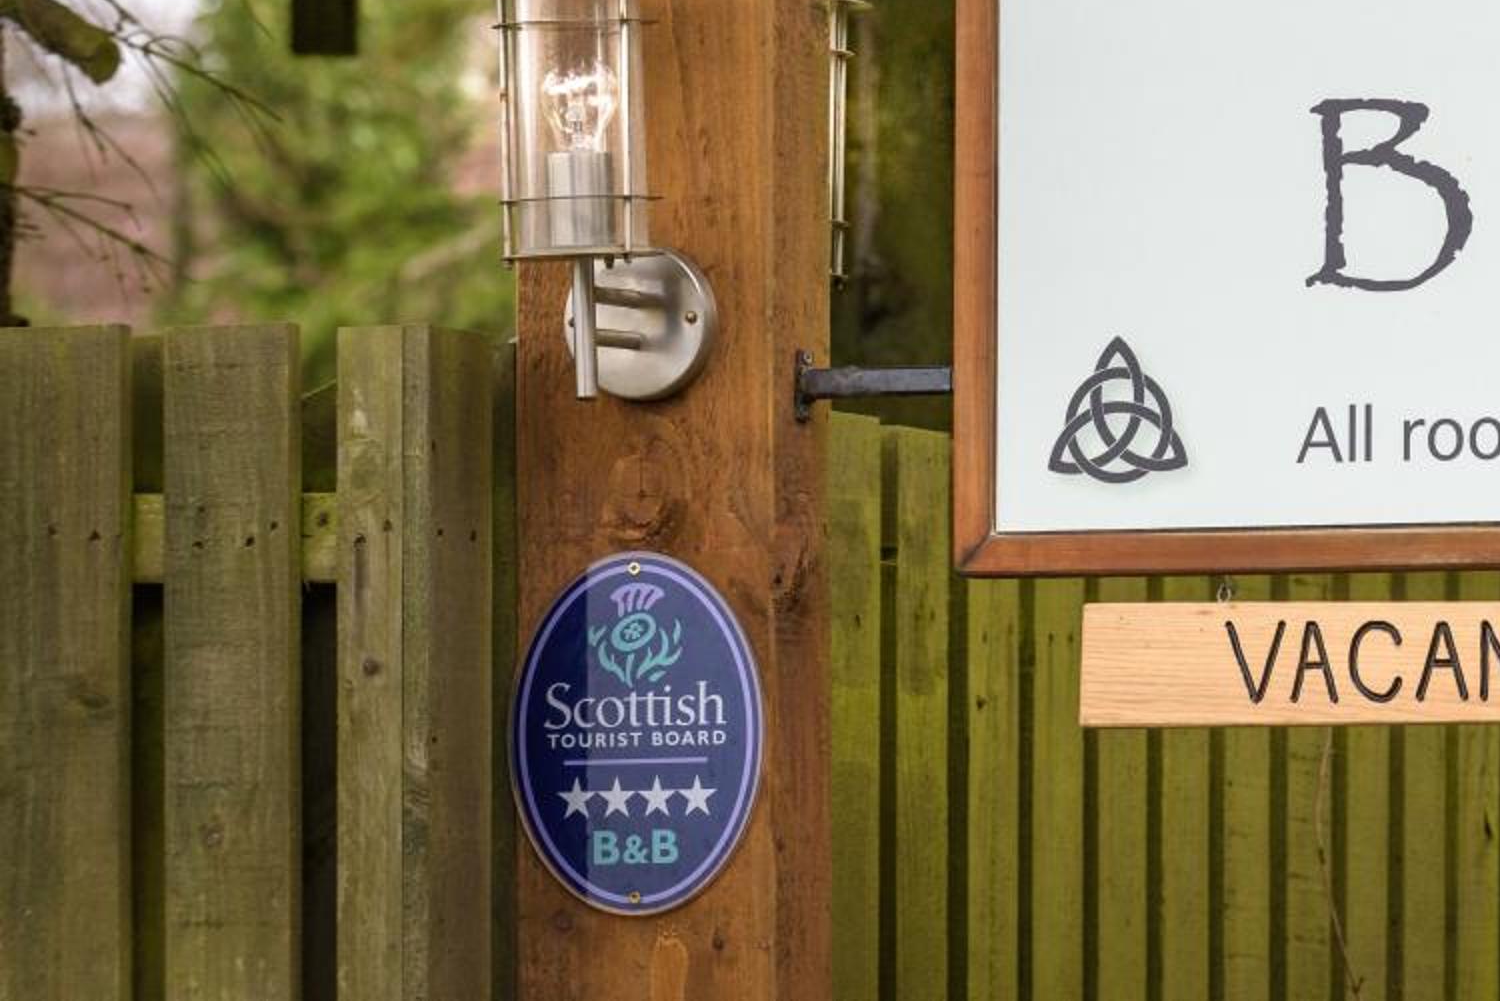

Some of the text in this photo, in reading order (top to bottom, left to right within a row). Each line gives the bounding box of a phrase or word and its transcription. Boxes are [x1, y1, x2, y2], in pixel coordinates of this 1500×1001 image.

[1305, 97, 1474, 293] B
[1297, 403, 1374, 465] All
[544, 680, 728, 730] Scottish
[548, 730, 727, 749] TOURIST BOARD
[593, 829, 679, 866] B&B
